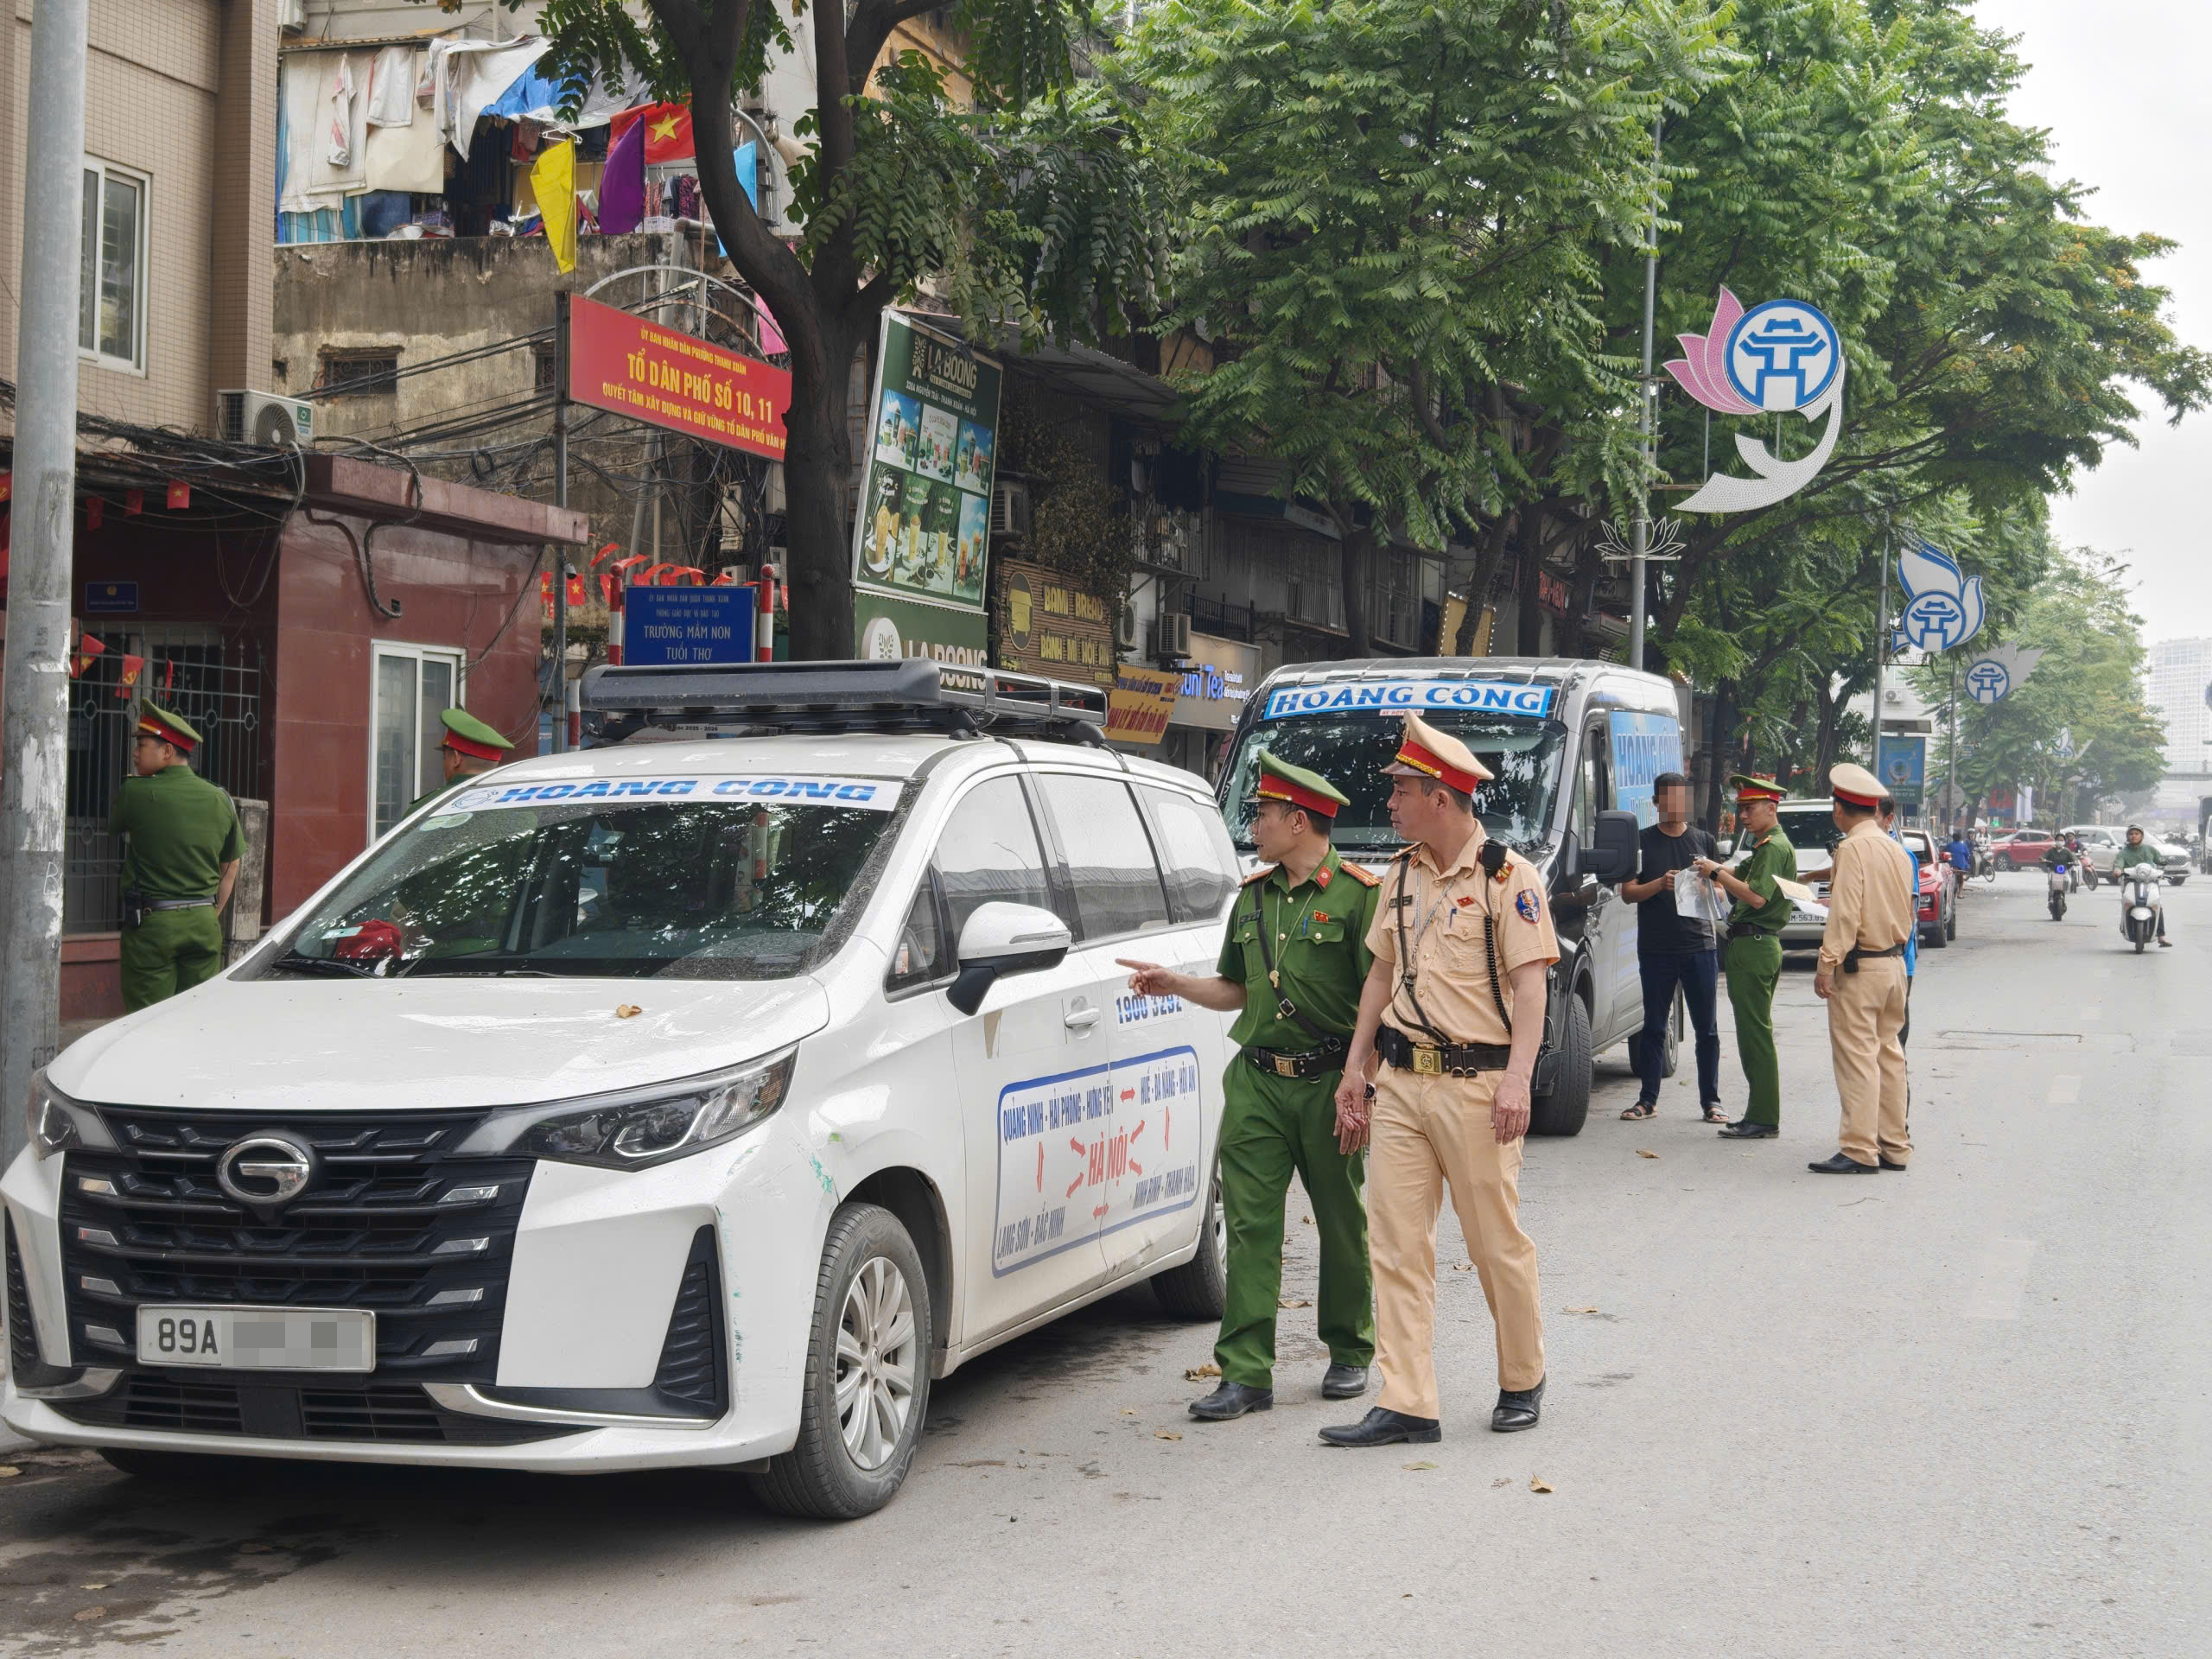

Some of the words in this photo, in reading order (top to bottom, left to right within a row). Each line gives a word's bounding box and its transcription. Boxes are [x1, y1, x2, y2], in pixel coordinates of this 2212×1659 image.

[649, 331, 662, 346] BAN
[662, 335, 678, 351] NHÂN
[679, 340, 690, 356] DÂN
[691, 347, 714, 364] PHƯỜNG
[715, 354, 732, 371] THANH
[732, 360, 747, 376] XUÂN
[926, 345, 942, 375] LA
[943, 352, 977, 390] BOONG
[626, 347, 645, 382] TỔ
[649, 359, 680, 394] DÂN
[683, 372, 712, 404] PHỐ
[714, 378, 733, 411] SỐ
[735, 391, 754, 421] 10,
[758, 397, 772, 423] 11
[602, 382, 626, 402] QUYẾT
[627, 389, 644, 407] TÂM
[645, 396, 660, 412] XÂY
[661, 400, 682, 418] DỰNG
[683, 405, 692, 423] VÀ
[727, 419, 735, 435] TỔ
[736, 423, 750, 440] DÂN
[751, 428, 765, 445] PHỐ
[1043, 585, 1069, 616] BAMI
[1074, 591, 1103, 621] BREAD
[643, 621, 683, 639] TRƯỜNG
[687, 620, 708, 639] MẦM
[711, 626, 731, 639] NON
[665, 641, 688, 661] TUỔI
[692, 646, 713, 661] THƠ
[1040, 630, 1063, 661] BÁNH
[934, 643, 988, 690] BOONG
[1205, 664, 1224, 699] Tea
[1274, 685, 1414, 714] HOÀNG
[1426, 683, 1541, 710] CÔNG
[1617, 726, 1656, 789] HOÀNG
[494, 780, 699, 803] HOÀNG
[712, 778, 877, 802] CÔNG
[1116, 995, 1148, 1024] 1900
[1140, 1065, 1151, 1105] HUẾ
[1179, 1060, 1188, 1100] HỘI
[1188, 1065, 1196, 1092] AN
[1003, 1096, 1027, 1146] QUẢNG
[1027, 1102, 1044, 1136] NINH
[1049, 1087, 1060, 1130] HẢI
[1061, 1086, 1082, 1128] PHÒNG
[1086, 1087, 1102, 1121] HƯNG
[1103, 1079, 1114, 1116] YÊN
[1087, 1131, 1104, 1187] HÀ
[1106, 1126, 1128, 1187] NỘI
[1132, 1179, 1149, 1210] NINH
[1164, 1167, 1184, 1199] THANH
[1183, 1159, 1195, 1194] HÓA
[996, 1223, 1016, 1265] LẠNG
[1014, 1216, 1031, 1253] SƠN
[1033, 1200, 1049, 1246] BẮC
[1047, 1205, 1066, 1241] NINH
[157, 1317, 219, 1355] 89A
